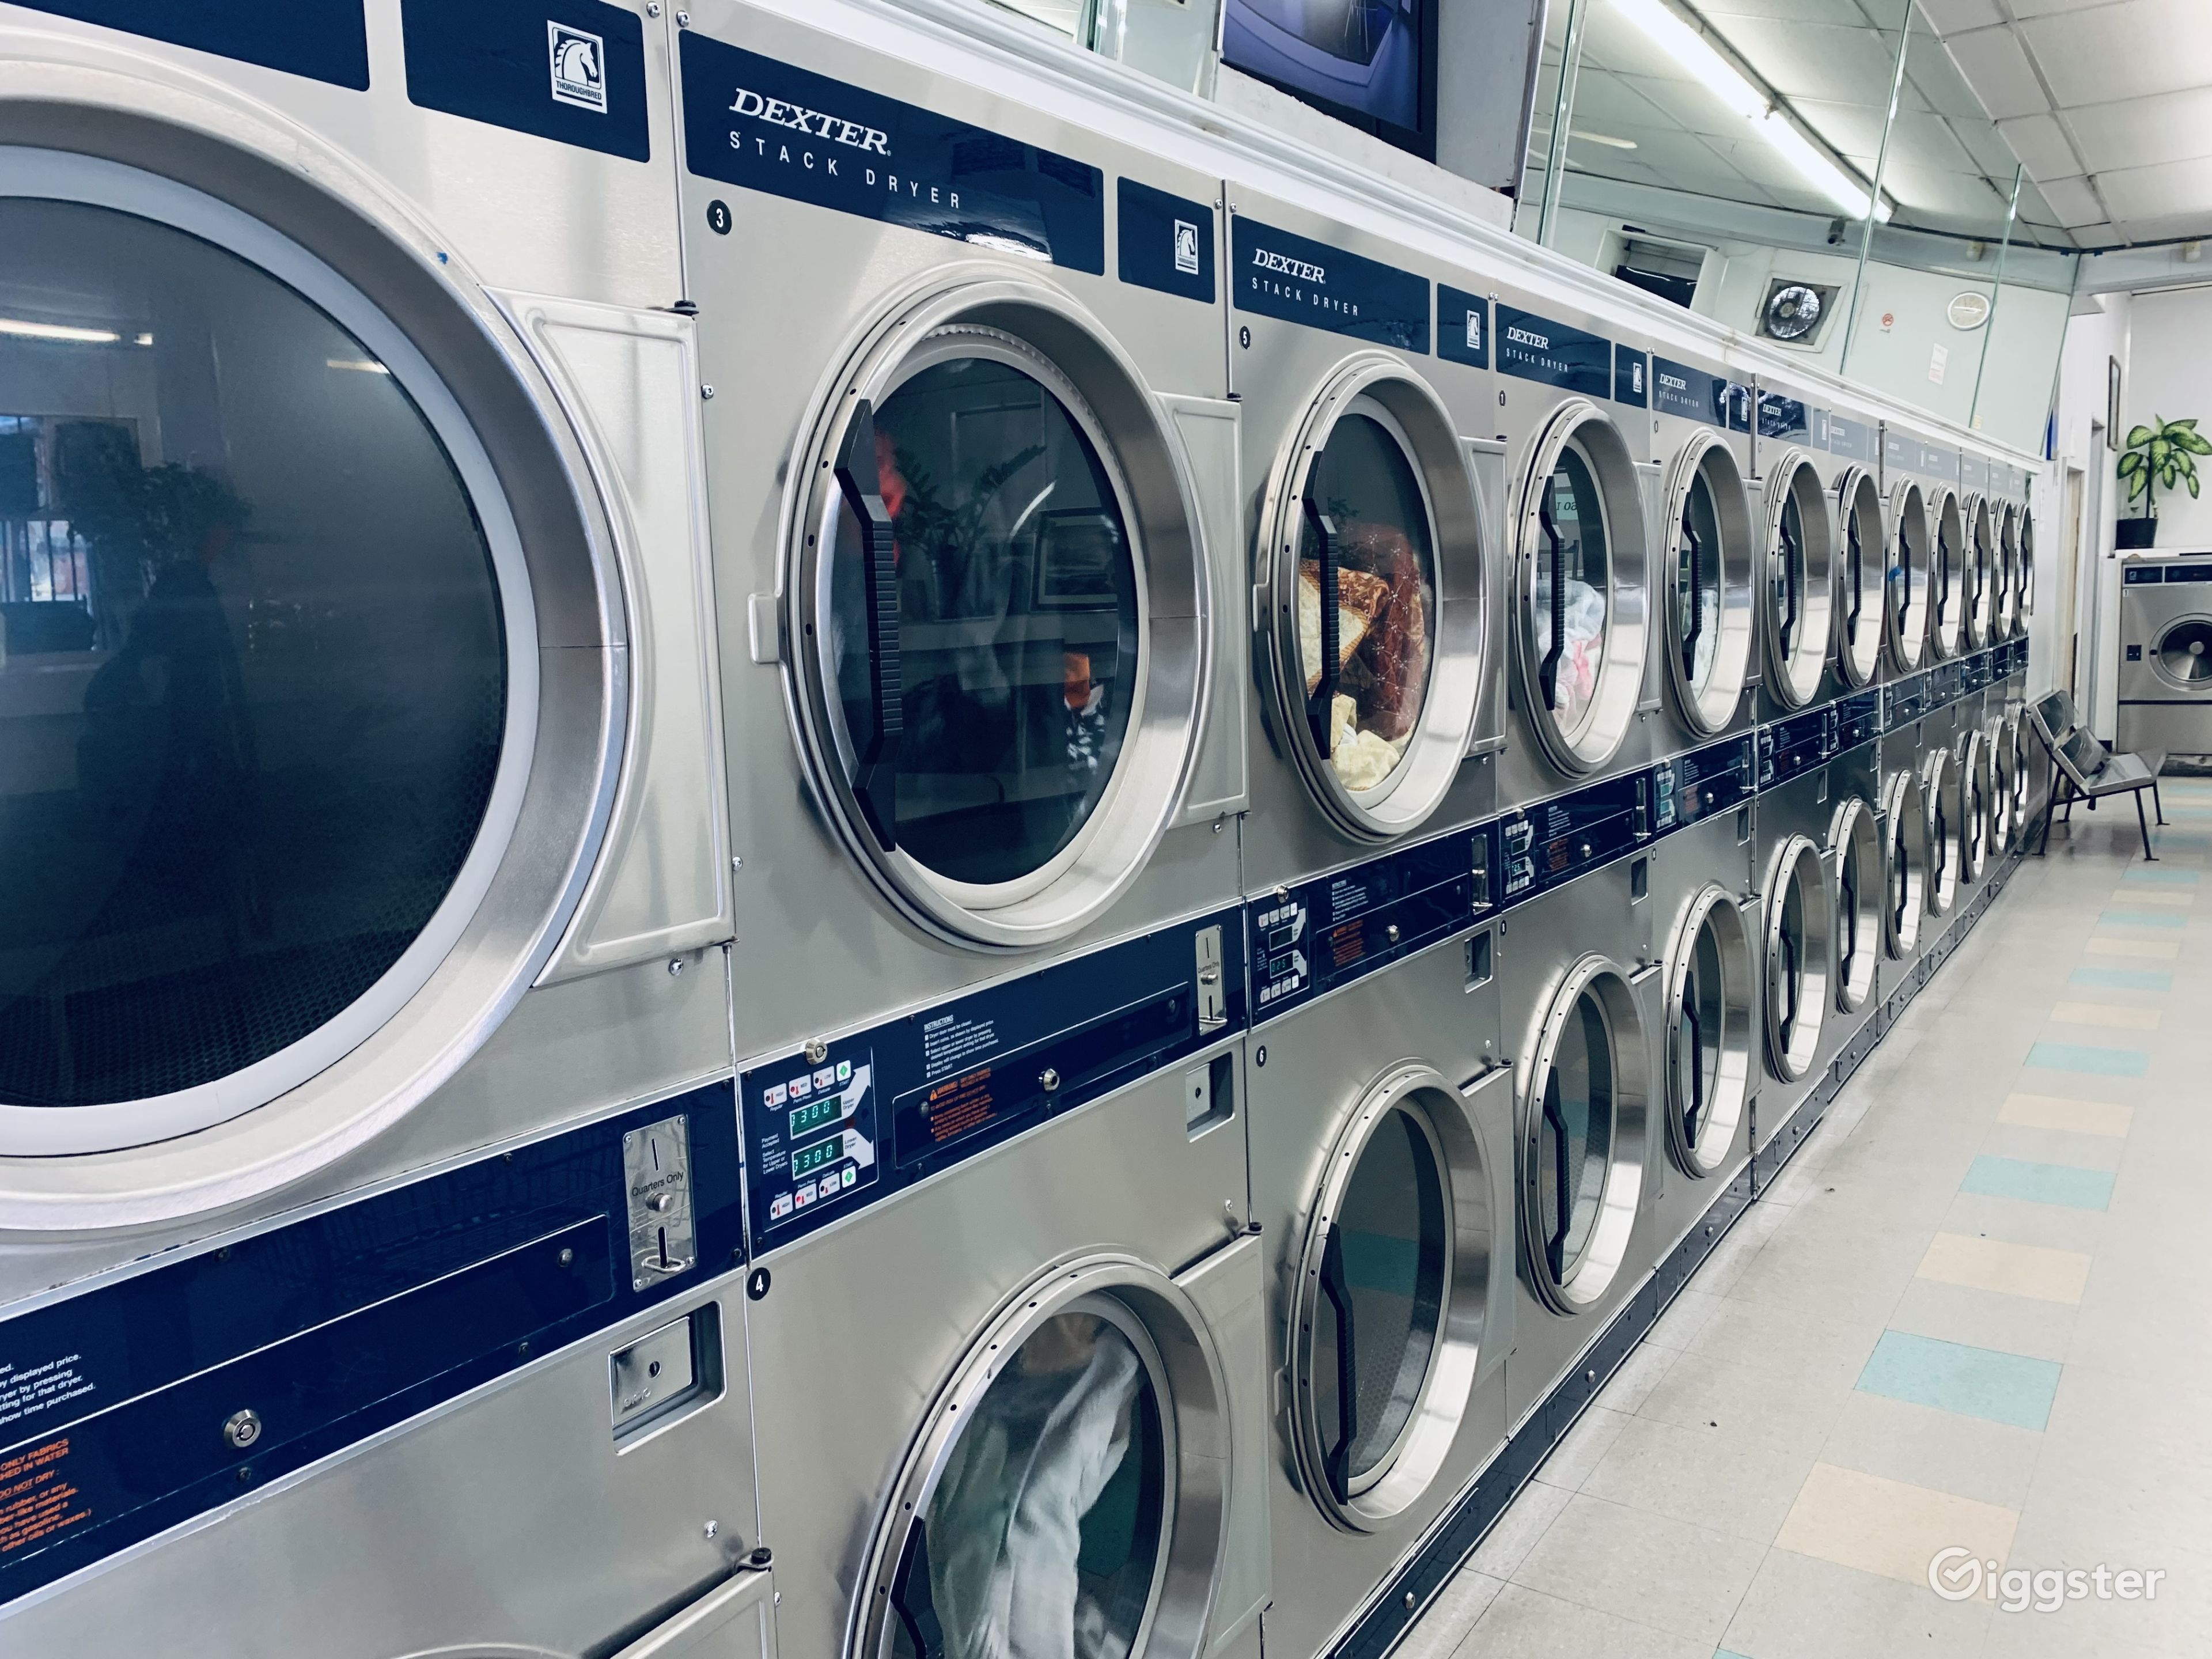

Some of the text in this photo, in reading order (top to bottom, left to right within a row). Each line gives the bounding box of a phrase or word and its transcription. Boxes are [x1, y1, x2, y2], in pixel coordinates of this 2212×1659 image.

[556, 80, 602, 100] THOROUGHBRED
[729, 88, 888, 156] DEXTER
[730, 131, 959, 209] STACK DRYER
[716, 208, 724, 228] 3
[1252, 248, 1325, 283] DEXTER
[1252, 276, 1358, 316] STACK DRYER
[1243, 331, 1248, 345] 5
[1506, 327, 1549, 350] DEXTER
[1506, 348, 1569, 373] STACK DRYER
[1659, 373, 1687, 390] DEXTER
[1762, 404, 1782, 416] DEXTER
[924, 1014, 953, 1031] INSTRUCTIONS
[1260, 1050, 1264, 1062] 6
[631, 1171, 684, 1197] Quarters Only
[756, 1275, 763, 1291] 4
[10, 1362, 54, 1384] displayed
[56, 1354, 81, 1369] price.
[20, 1385, 31, 1393] by
[33, 1369, 73, 1390] pressing
[22, 1393, 35, 1402] for
[38, 1385, 55, 1396] that
[58, 1375, 83, 1389] dryer.
[24, 1403, 44, 1415] time
[47, 1382, 96, 1408] purchased.
[1, 1438, 69, 1471] ONLY FABRICS
[24, 1462, 33, 1471] IN
[35, 1448, 69, 1466] WATER
[14, 1479, 33, 1493] NOT
[39, 1490, 49, 1498] or
[51, 1482, 67, 1494] any
[14, 1515, 37, 1528] have
[37, 1503, 60, 1518] used
[2, 1537, 25, 1552] other
[28, 1529, 44, 1541] oils
[46, 1525, 55, 1533] or
[9, 1531, 20, 1540] as
